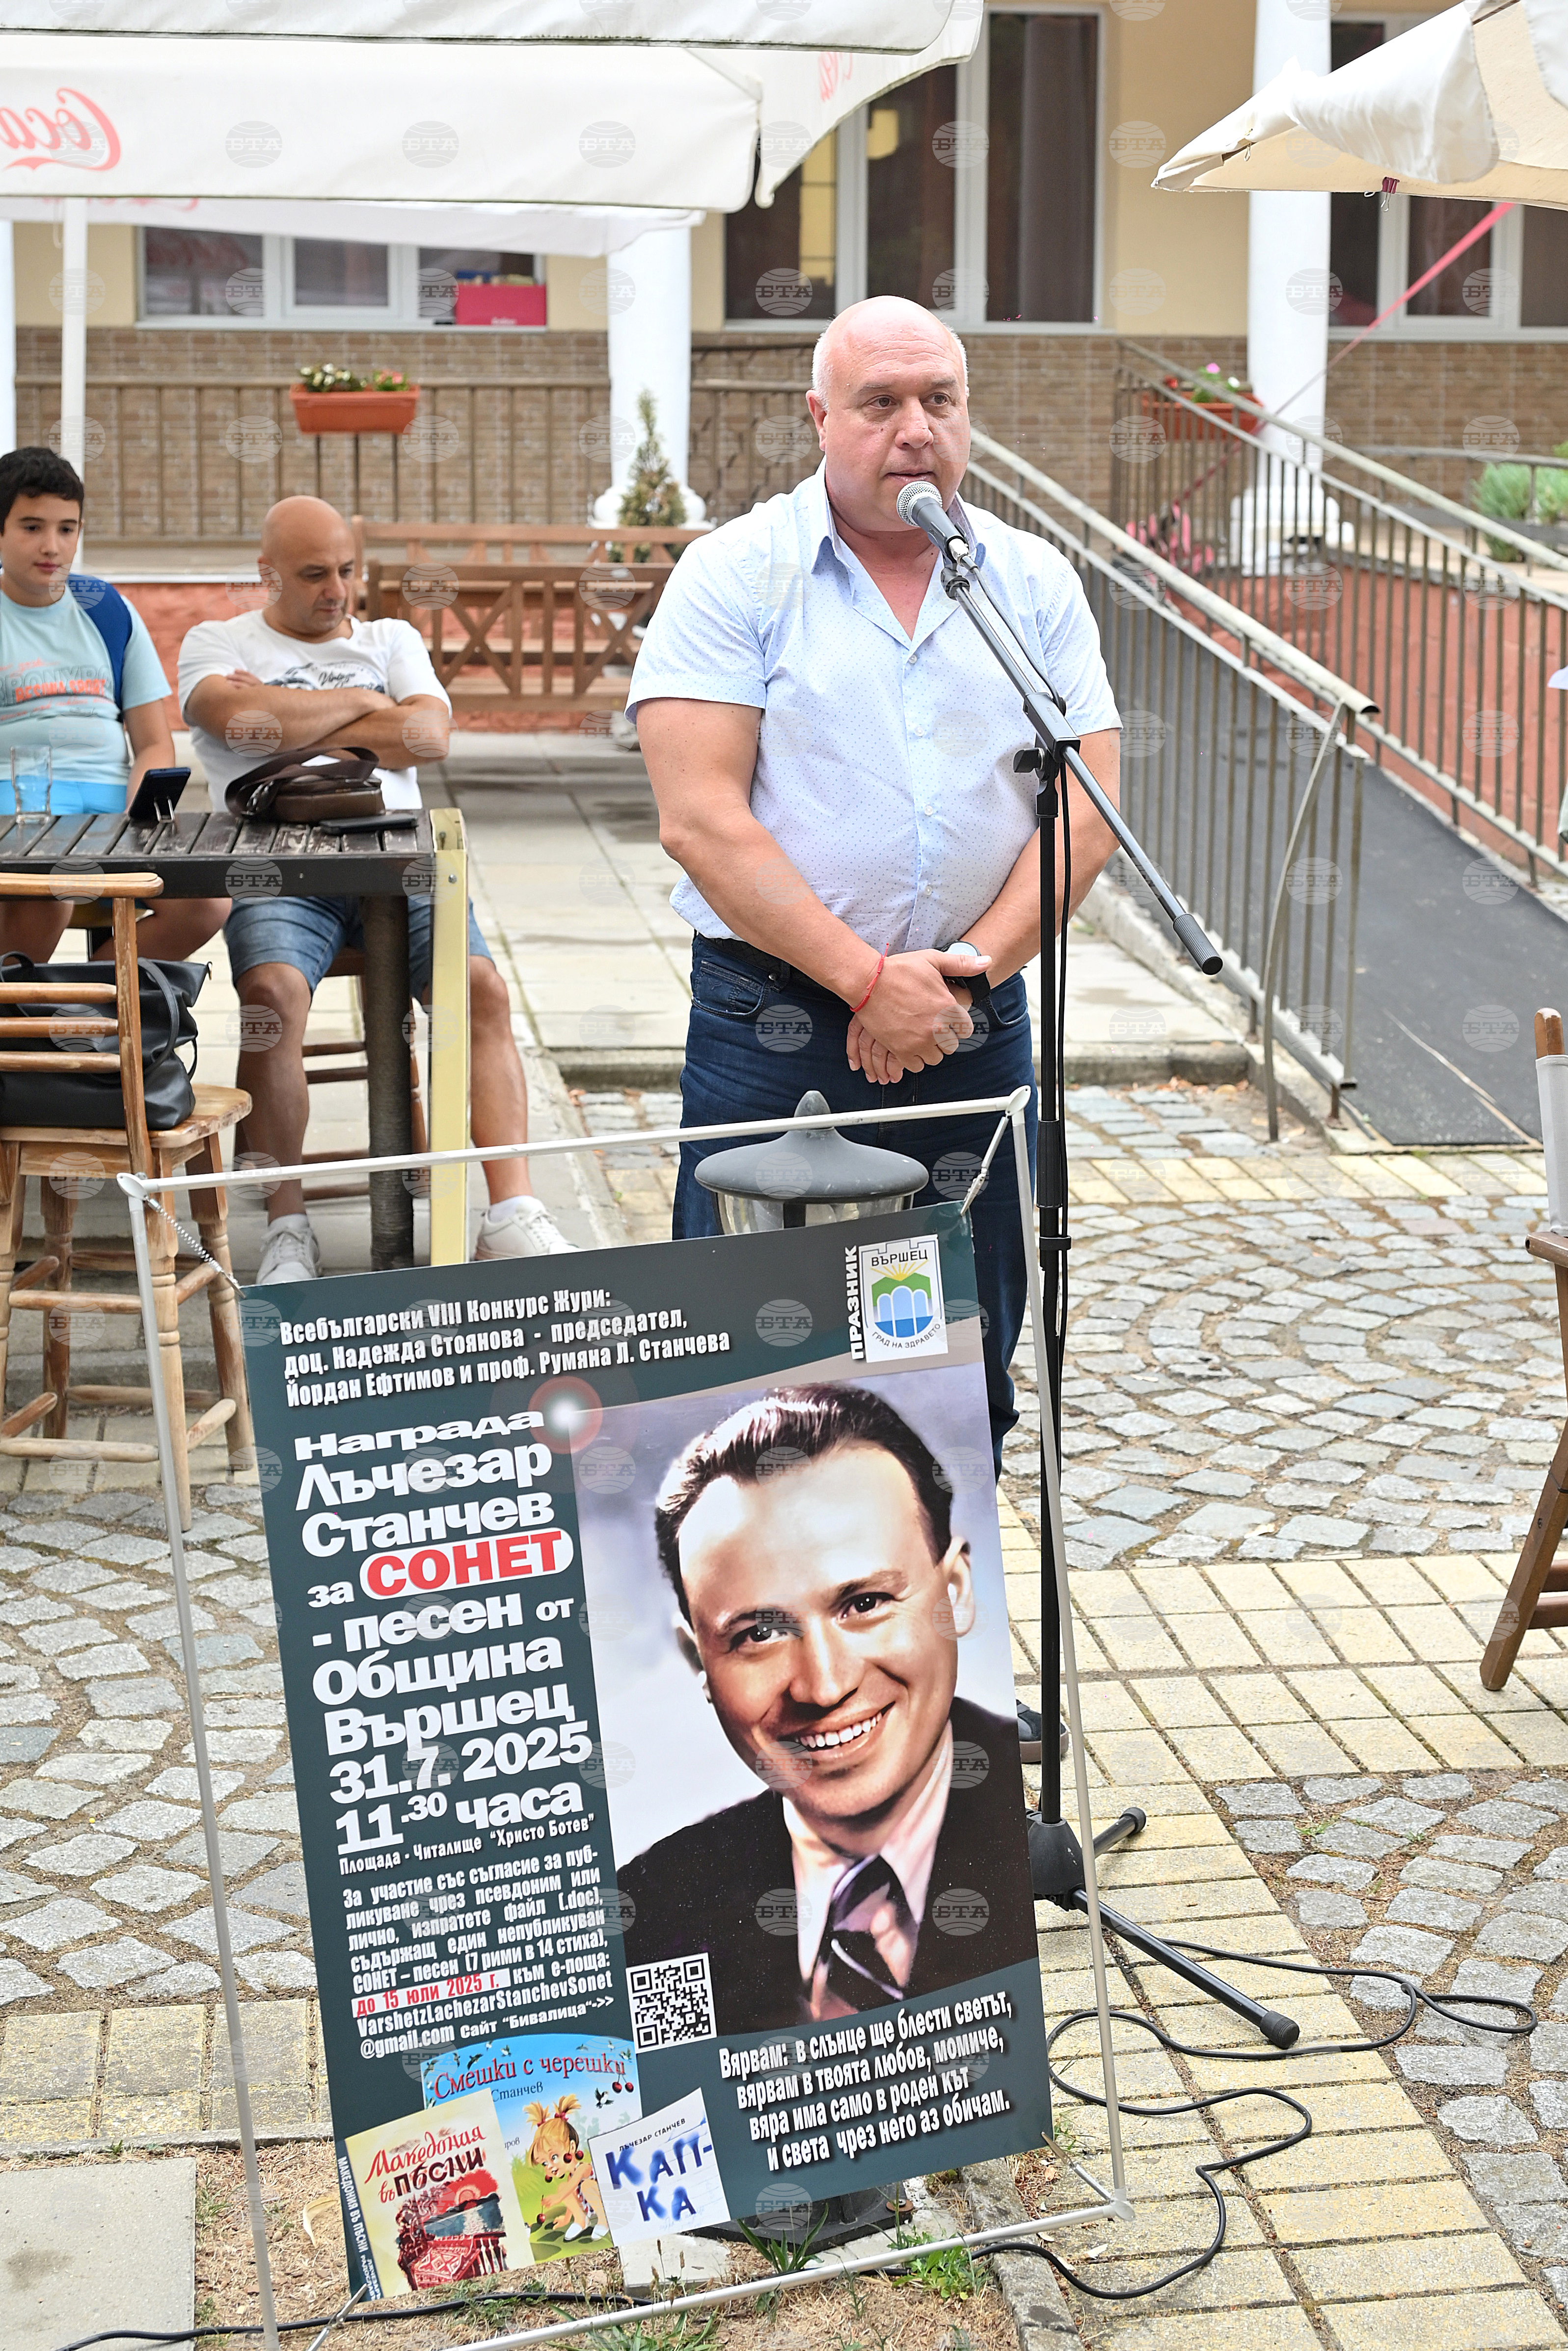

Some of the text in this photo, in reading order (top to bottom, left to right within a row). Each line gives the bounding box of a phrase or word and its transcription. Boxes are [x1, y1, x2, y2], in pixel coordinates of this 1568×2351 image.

[871, 1249, 928, 1266] ВЪРШЕЦ
[279, 1289, 611, 1345] Всебългарски VIII Конкурс Жури:
[845, 1245, 864, 1360] ПРАЗНИК
[284, 1352, 329, 1379] доц.
[332, 1340, 426, 1370] Надежда
[431, 1328, 524, 1357] Стоянова
[550, 1309, 687, 1343] председател,
[872, 1332, 890, 1346] ГРАД
[905, 1324, 941, 1348] ЗДРАВЕТО
[286, 1332, 730, 1407] Йордан Ефтимов и проф. Румяна Л. Станчева
[294, 1411, 545, 1461] Награда
[295, 1443, 552, 1520] Лъчезар
[301, 1480, 555, 1558] Станчев
[307, 1530, 562, 1608] за СОНЕТ
[343, 1592, 523, 1652] песен
[536, 1598, 574, 1621] от
[312, 1637, 564, 1714] Община
[324, 1683, 576, 1756] Вършец
[329, 1718, 593, 1804] 31.7. 2025
[455, 1781, 584, 1830] часа
[339, 1851, 401, 1875] Площада
[413, 1836, 482, 1860] Читалище
[343, 1844, 598, 1908] За участие със съгласие за пуб-
[346, 1867, 600, 1930] ликуване чрез псевдоним или
[348, 1927, 400, 1951] лично,
[411, 1909, 491, 1939] изпратете
[503, 1897, 546, 1923] файл
[351, 1909, 605, 1973] съдържащ един непубликуван
[352, 1967, 397, 1995] СОНЕТ
[412, 1958, 459, 1982] песен
[465, 1951, 478, 1972] (7
[481, 1946, 522, 1971] рими
[524, 1944, 535, 1961] в
[537, 1937, 554, 1958] 14
[556, 1928, 608, 1955] стиха),
[356, 1952, 610, 2018] до 15 юли 2025 г. към е-поща:
[356, 1970, 613, 2038] VarshetzLachezarStanchevSonet
[360, 2024, 455, 2059] @gmail.com
[719, 1991, 1012, 2081] Вярвам: в слънце ще блести светът,
[434, 2053, 626, 2100] Смешки с черешки
[491, 2081, 543, 2102] Станчев
[736, 2026, 1003, 2111] вярвам в твоята любов, момиче,
[619, 2118, 686, 2152] ЛЪЧЕЗАР СТАНЧЕВ
[749, 2066, 969, 2143] вяра има само в роден кът
[766, 2089, 1010, 2171] и света чрез него аз обичам.
[364, 2126, 486, 2184] Македония
[504, 2137, 520, 2150] ров
[338, 2156, 356, 2210] МАКЕДОНИЯ
[350, 2209, 361, 2223] ВЪ
[636, 2185, 697, 2222] КА
